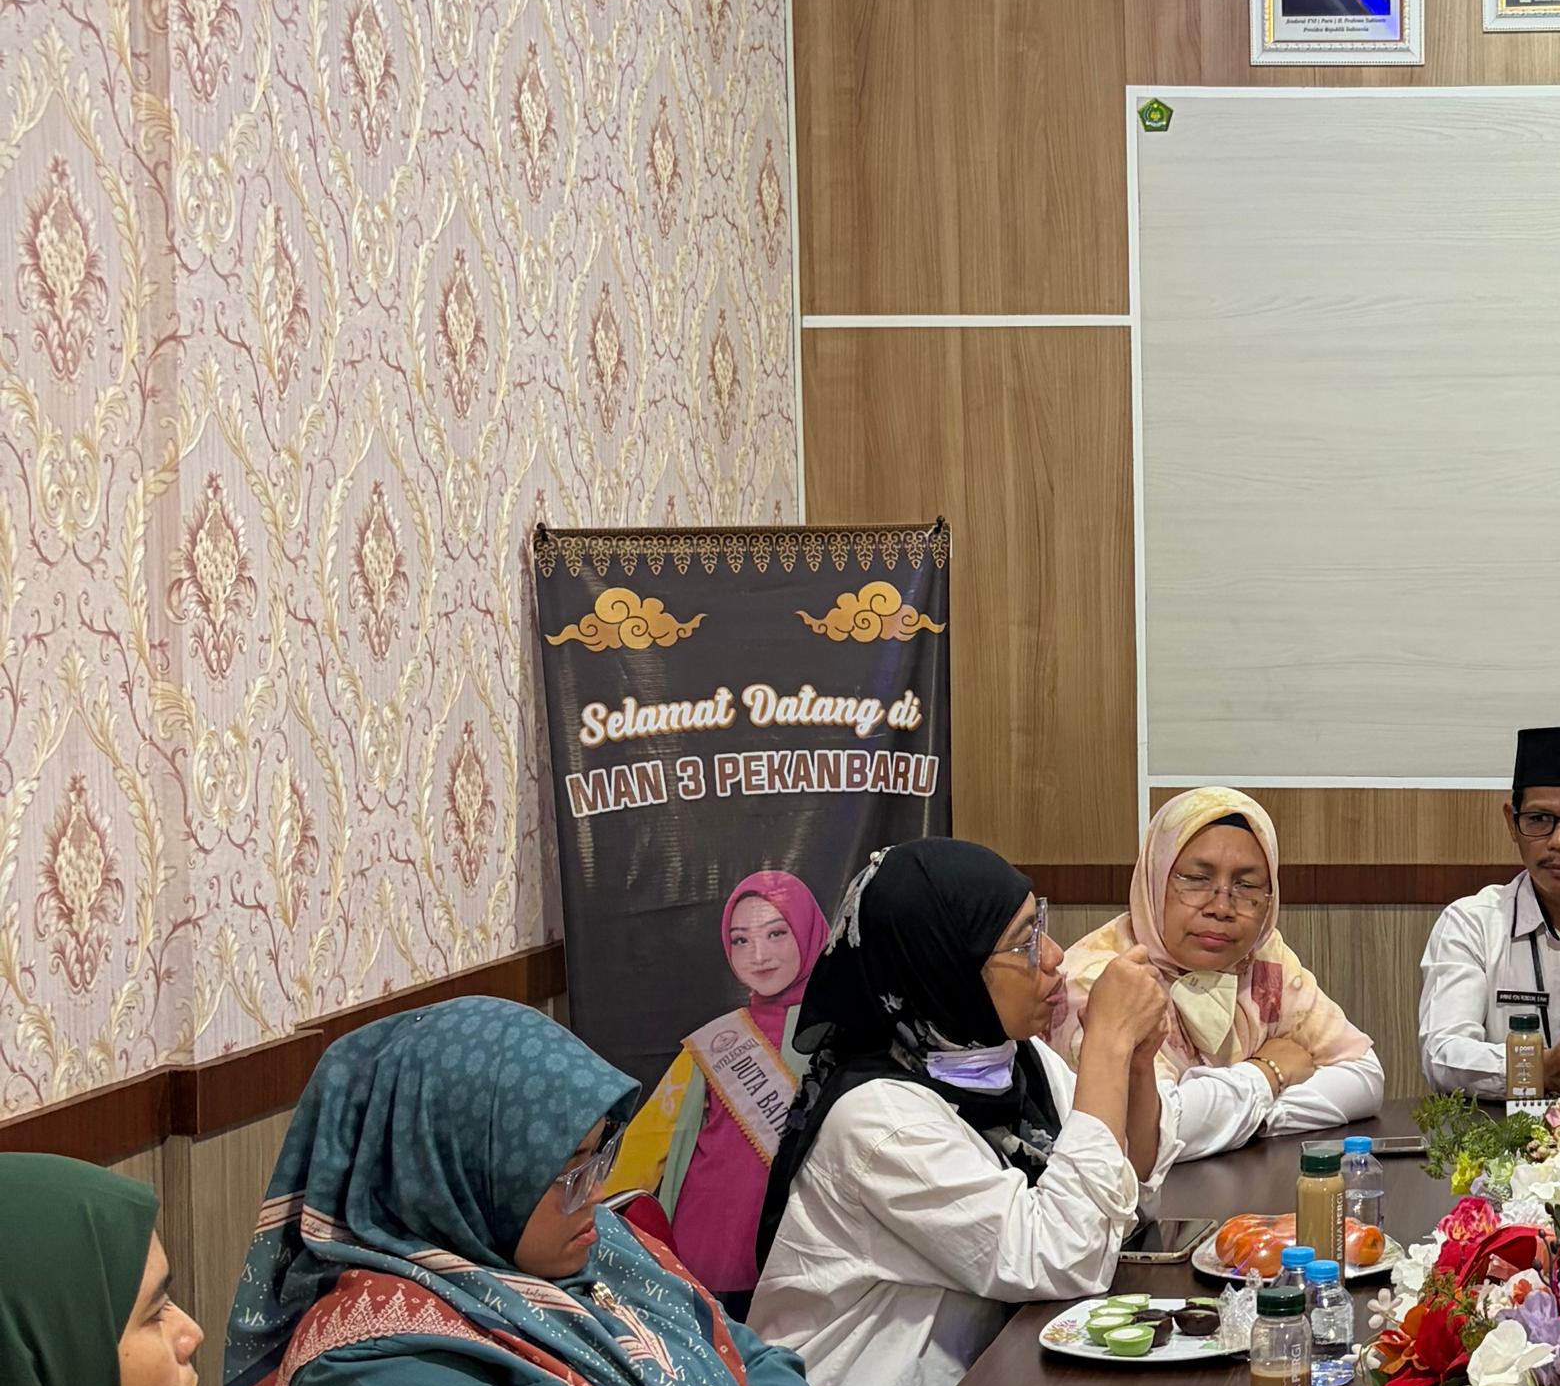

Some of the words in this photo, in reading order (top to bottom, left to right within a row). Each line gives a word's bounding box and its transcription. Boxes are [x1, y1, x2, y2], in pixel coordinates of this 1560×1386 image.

[579, 686, 735, 746] Selamat
[742, 684, 884, 739] Datang
[887, 689, 922, 732] di
[566, 760, 667, 817] MAN
[677, 757, 705, 800] 3
[714, 750, 939, 797] PEKANBARU
[730, 1056, 769, 1097] DUTA
[1291, 1344, 1301, 1382] PERGI
